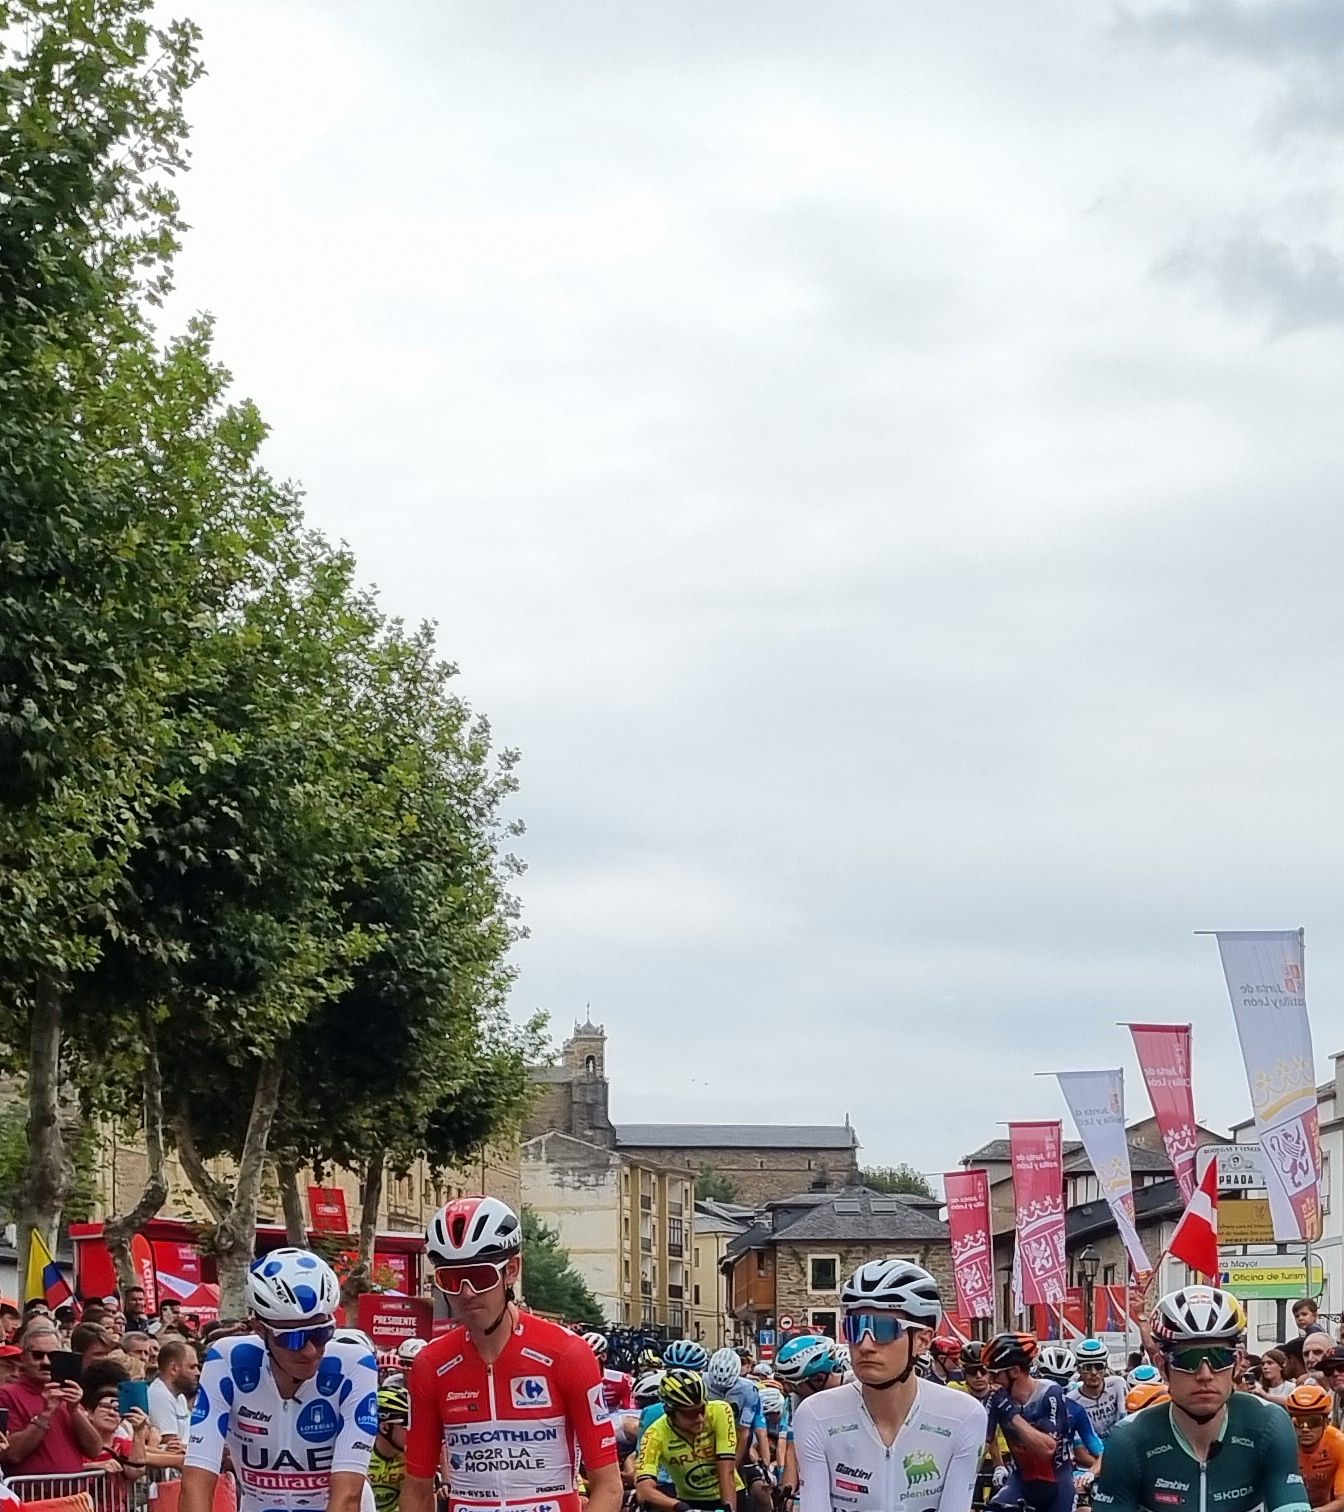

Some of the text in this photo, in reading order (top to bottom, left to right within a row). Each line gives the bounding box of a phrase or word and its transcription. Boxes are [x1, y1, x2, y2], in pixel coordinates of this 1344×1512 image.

[1219, 1174, 1254, 1186] PRADA
[1231, 1260, 1258, 1270] Mayor
[1233, 1270, 1306, 1282] Oficina de Turism
[237, 1405, 272, 1423] Santini
[460, 1428, 557, 1445] DECATHLON
[241, 1444, 333, 1472] UAE
[465, 1447, 531, 1460] AG2R LA
[465, 1458, 545, 1472] MONDIALE
[835, 1462, 873, 1481] Santini
[245, 1472, 329, 1489] Emirate
[1155, 1478, 1190, 1492] Santini
[900, 1486, 943, 1502] plenitud
